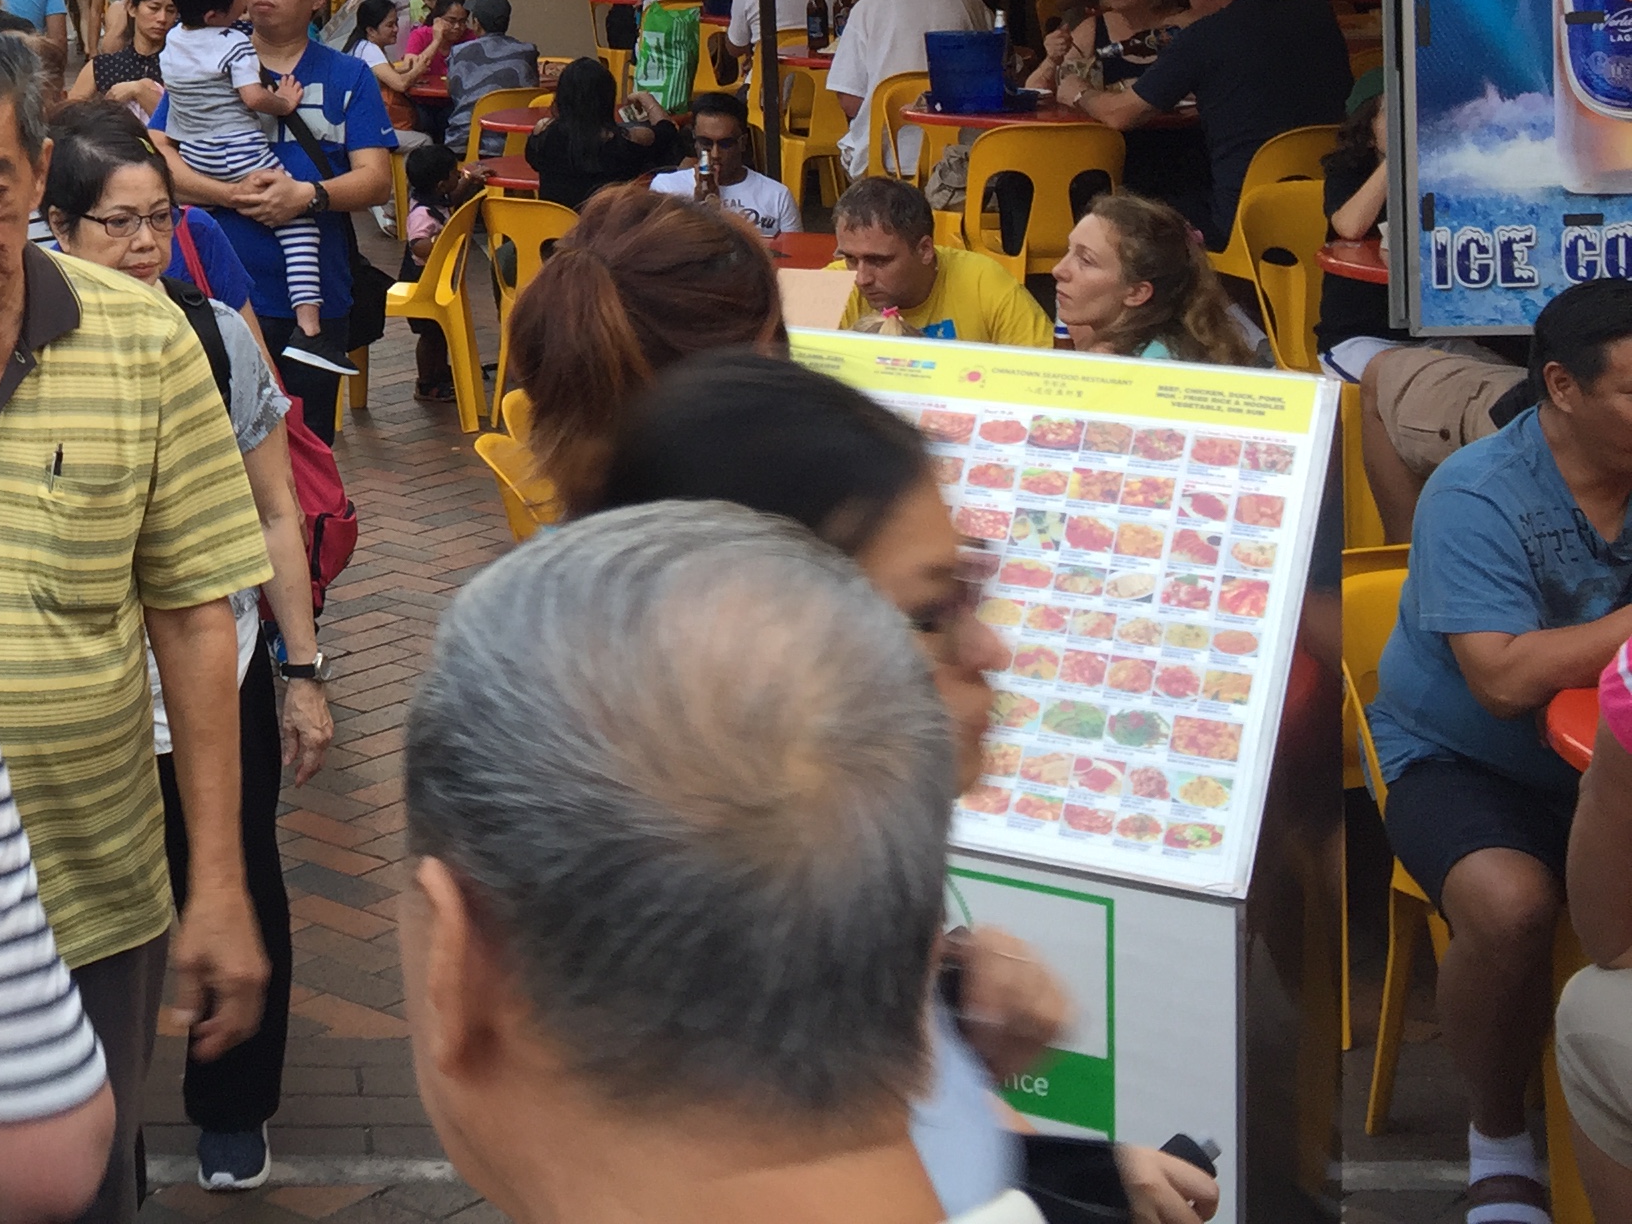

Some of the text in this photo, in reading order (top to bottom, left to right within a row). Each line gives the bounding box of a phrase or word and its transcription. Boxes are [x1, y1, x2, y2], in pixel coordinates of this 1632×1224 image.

[1431, 224, 1539, 289] ICE
[992, 367, 1134, 385] CHINATOWN SEAFOOD RESTAURANT
